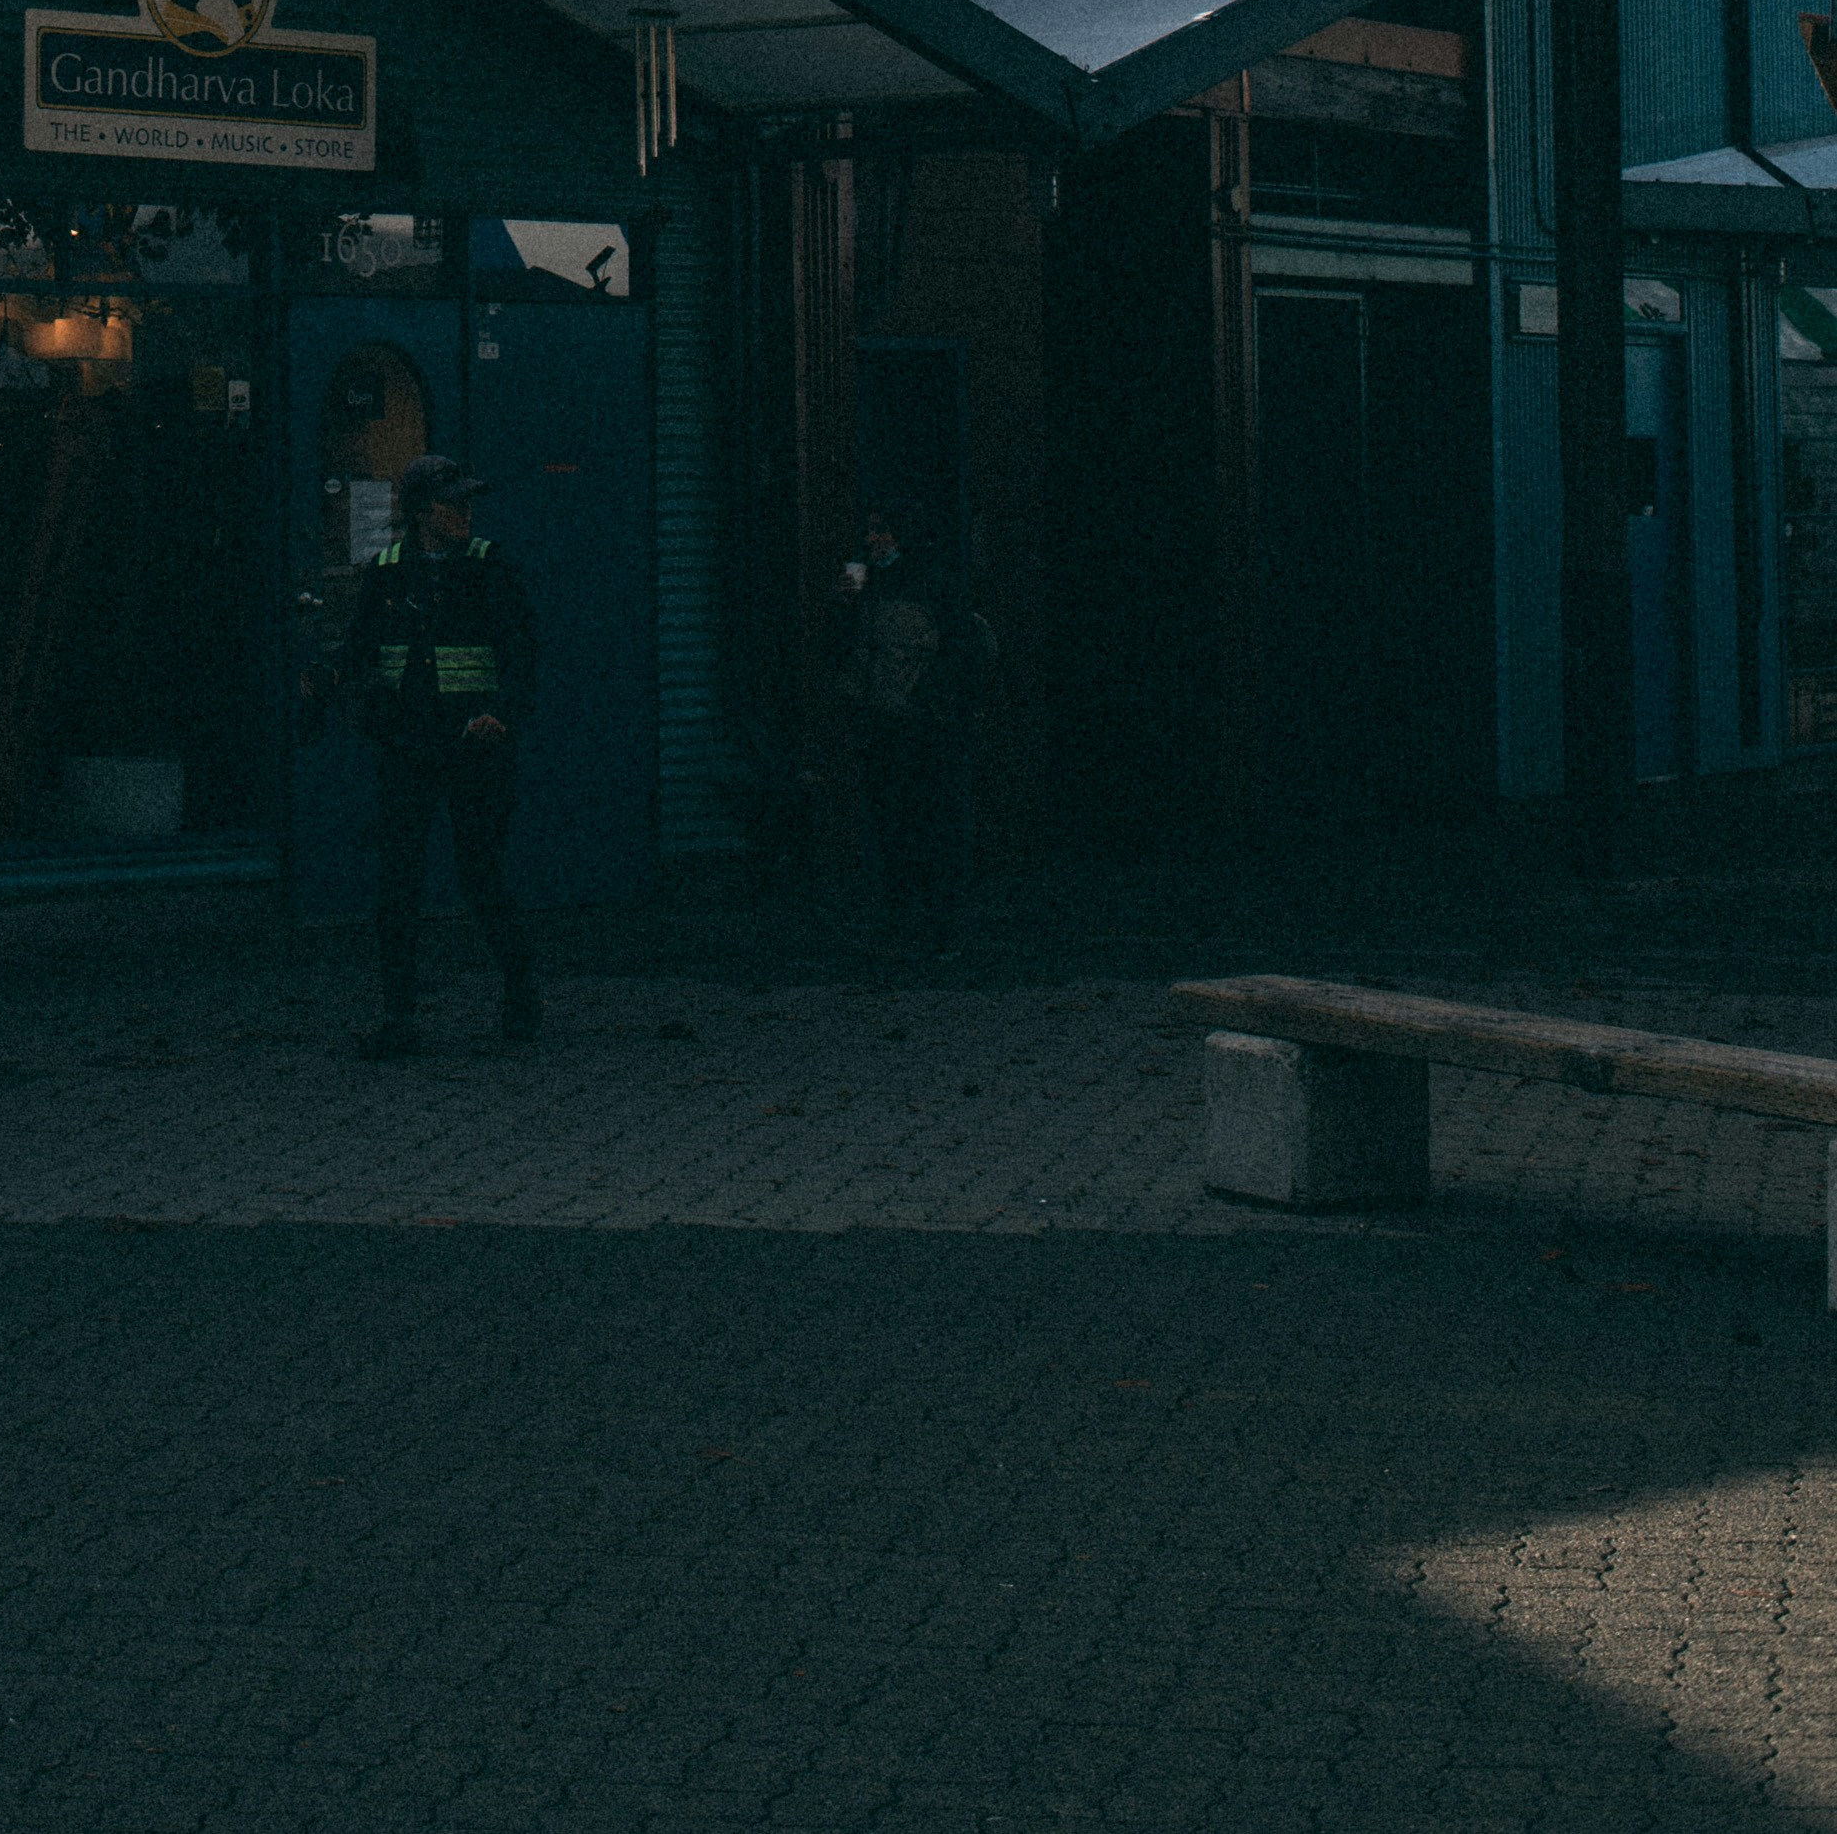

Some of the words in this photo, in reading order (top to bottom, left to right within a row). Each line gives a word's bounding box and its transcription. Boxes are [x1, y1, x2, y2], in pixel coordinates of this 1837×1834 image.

[50, 52, 256, 106] Gandharva
[272, 68, 355, 112] Loka
[50, 121, 91, 142] THE
[113, 126, 189, 149] WORLD
[211, 132, 272, 155] MUSIC
[295, 138, 354, 159] STORE
[321, 219, 402, 277] 1650
